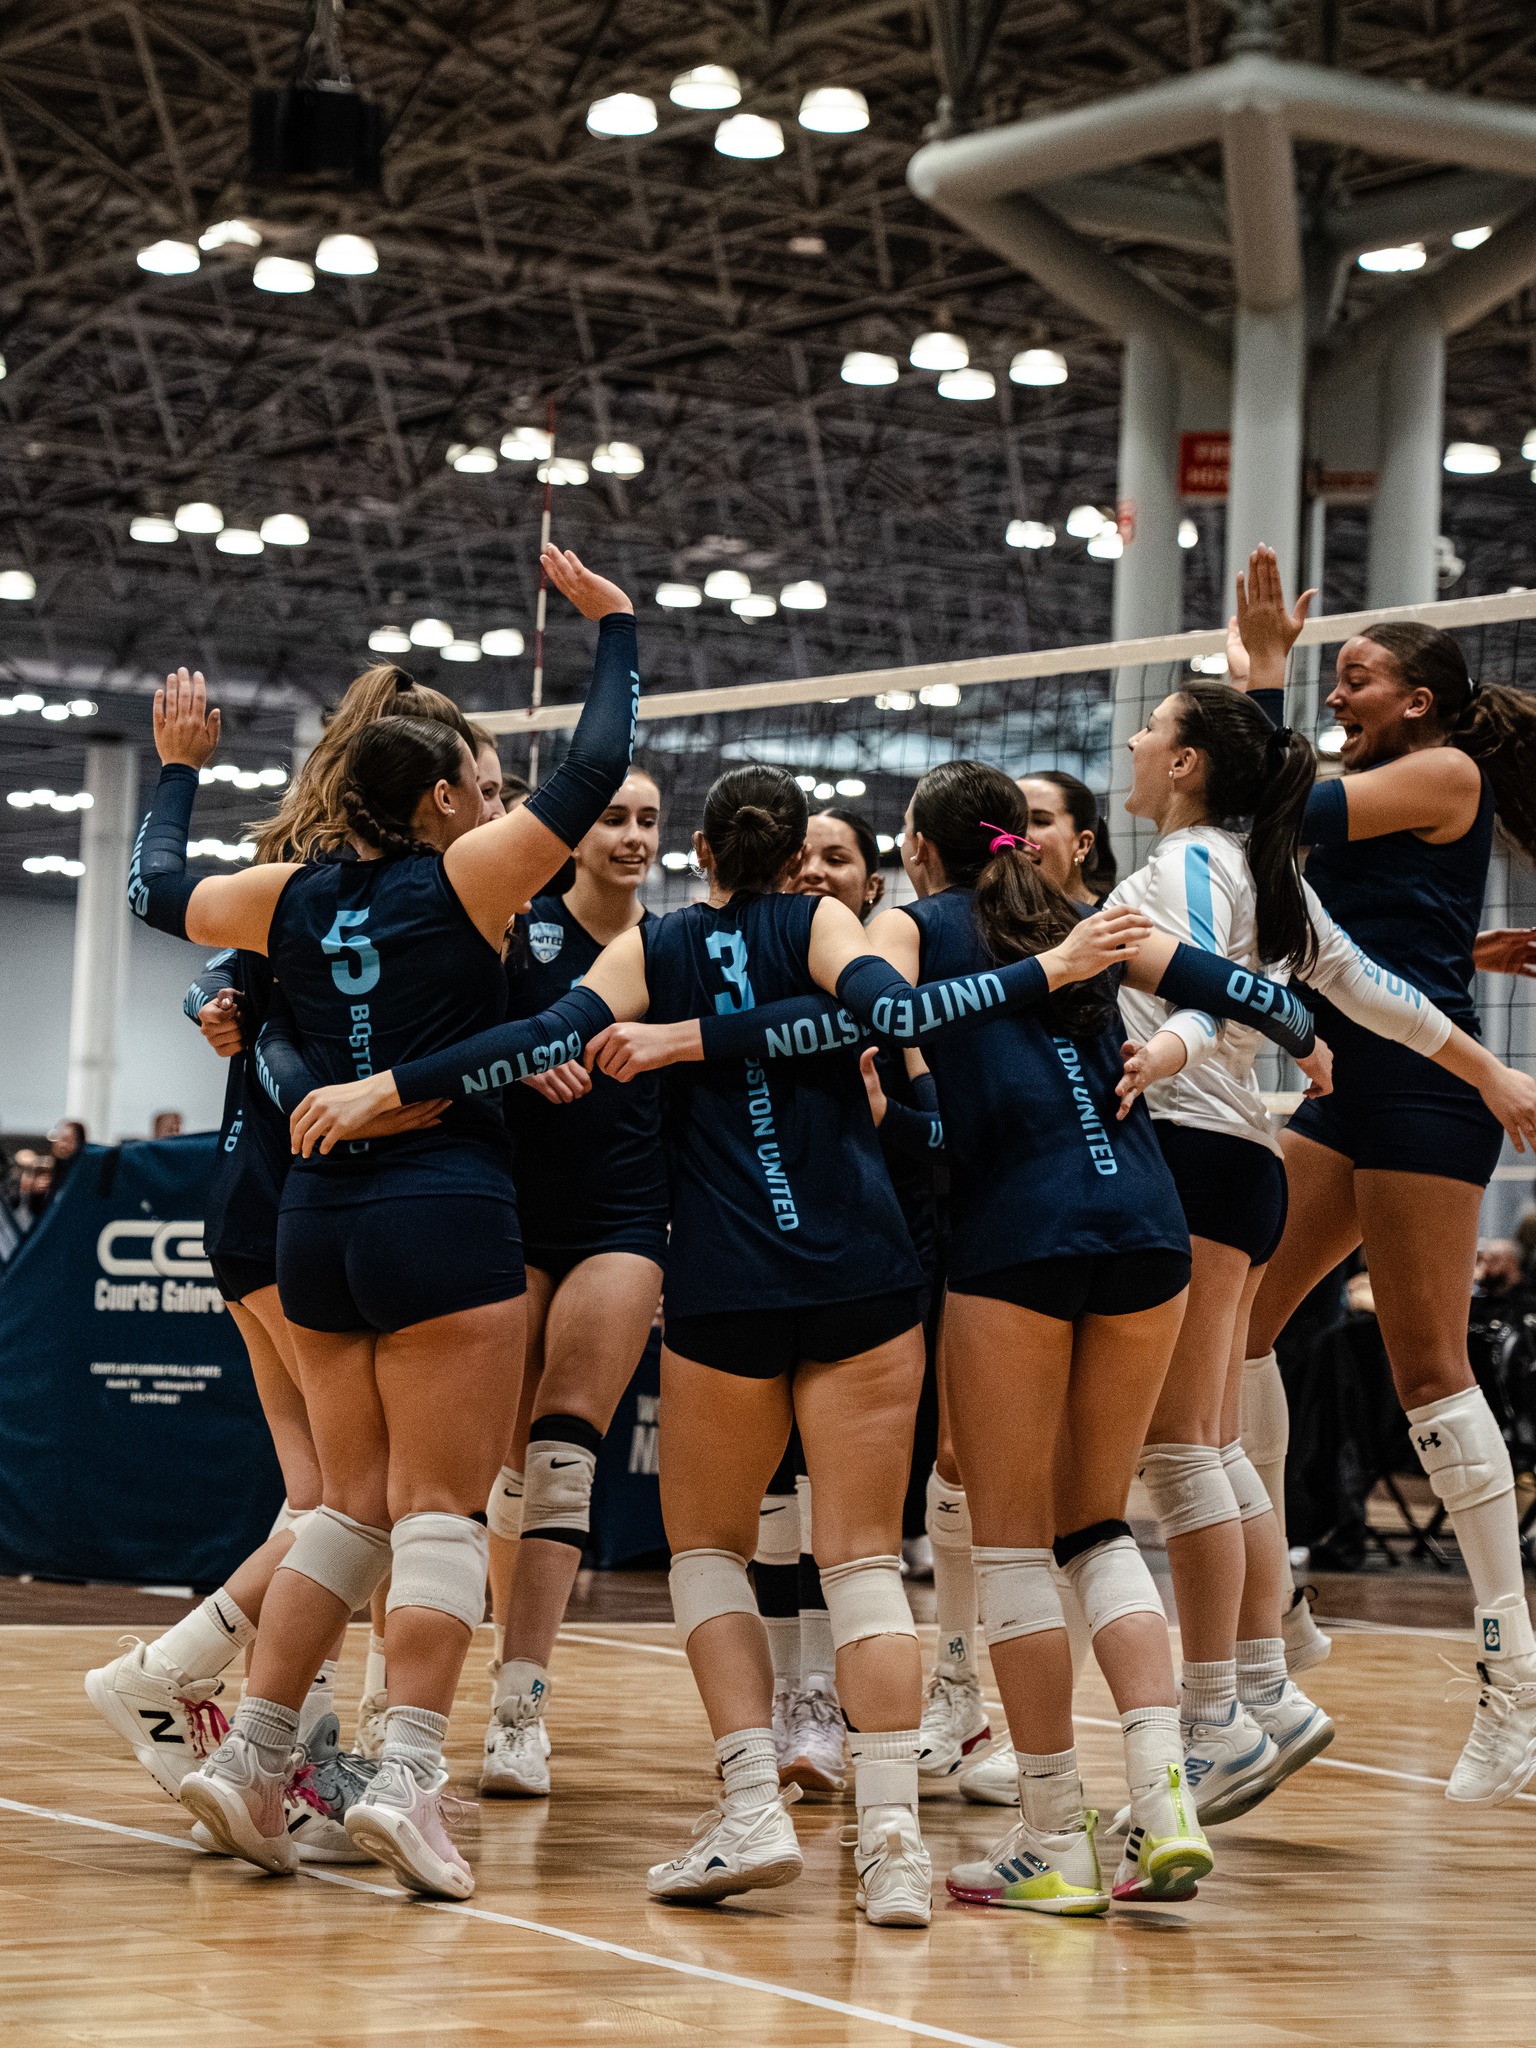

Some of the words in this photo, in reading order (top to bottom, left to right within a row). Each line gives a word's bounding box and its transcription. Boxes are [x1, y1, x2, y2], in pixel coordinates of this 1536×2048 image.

[321, 906, 381, 995] 5
[706, 930, 755, 1016] 3
[349, 1003, 373, 1080] BOSTO
[765, 1007, 872, 1058] STON
[871, 973, 1007, 1038] UNITED
[461, 1030, 582, 1095] BOSTON
[745, 1057, 776, 1138] STON
[1072, 1086, 1118, 1176] UNITED
[757, 1142, 800, 1232] UNITED
